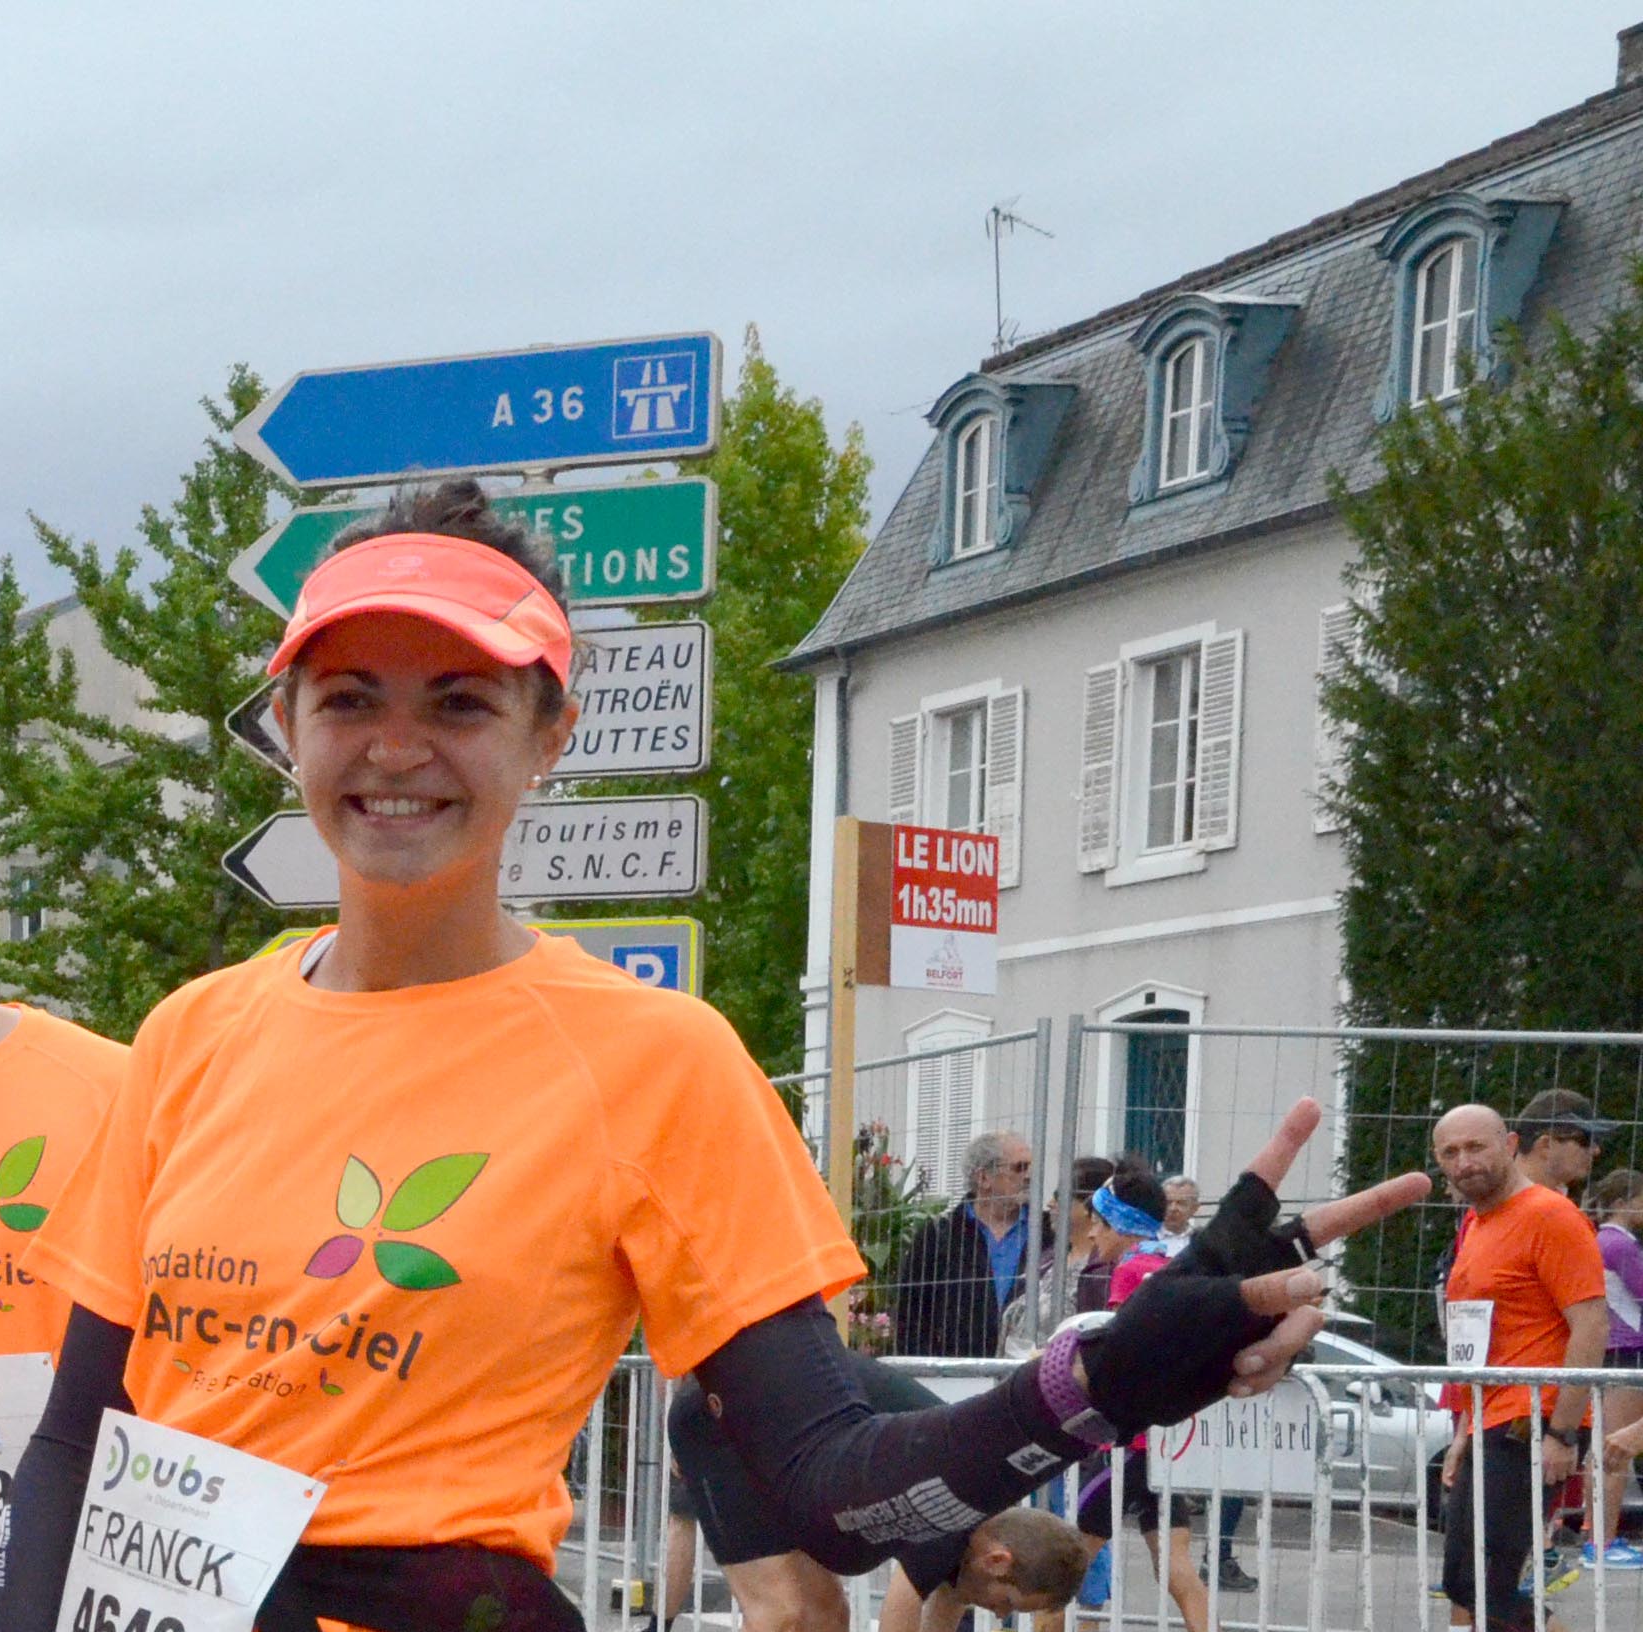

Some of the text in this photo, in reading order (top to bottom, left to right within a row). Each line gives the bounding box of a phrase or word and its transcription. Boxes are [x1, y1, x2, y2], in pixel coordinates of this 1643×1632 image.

[492, 386, 585, 428] A 36
[558, 544, 691, 587] TIONS
[581, 642, 694, 674] ATEAU
[581, 680, 694, 715] ITROËN
[563, 725, 691, 756] OUTTES
[518, 815, 683, 845] Tourisme
[548, 851, 682, 881] S.N.C.F.
[898, 832, 995, 877] LE LION
[898, 883, 993, 928] 1h35mn
[926, 968, 964, 980] BELFORT
[144, 1290, 424, 1381] Arc-en-Ciel
[103, 1425, 226, 1504] Doubs
[83, 1504, 236, 1598] FRANCK
